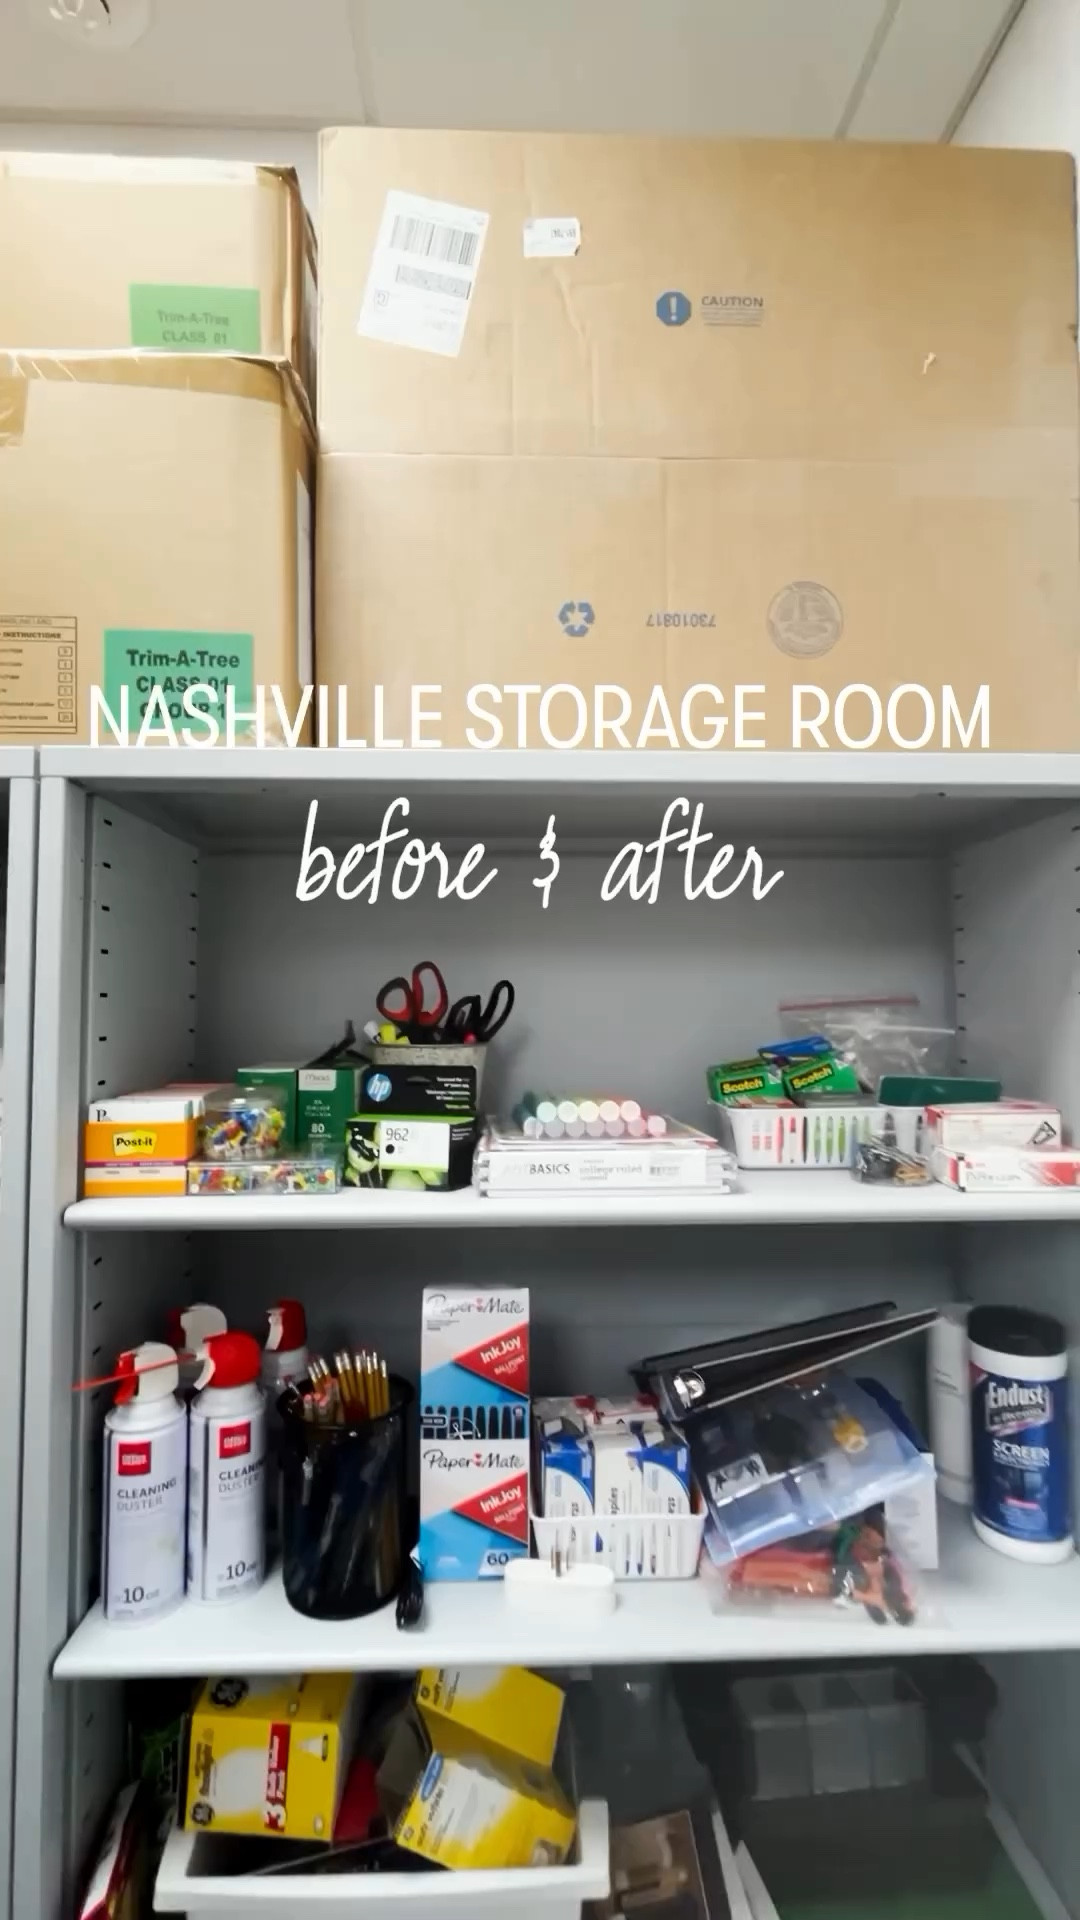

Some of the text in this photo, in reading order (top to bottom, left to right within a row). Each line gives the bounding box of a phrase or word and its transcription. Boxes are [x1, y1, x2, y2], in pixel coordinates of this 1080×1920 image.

[701, 295, 764, 307] CAUTION
[161, 329, 207, 343] CLASS
[126, 649, 240, 669] Trim-A-Tree
[721, 1077, 764, 1095] Scotch
[792, 1064, 834, 1090] Scotch
[368, 1073, 392, 1103] hp
[115, 1137, 154, 1147] Post-it
[385, 1127, 410, 1142] 962
[480, 1336, 521, 1365] InkJoy
[987, 1382, 1045, 1409] Endust
[423, 1448, 525, 1472] Paper Mate
[116, 1476, 177, 1500] CLEANING
[480, 1485, 522, 1514] InkJoy
[486, 1553, 509, 1566] 60
[226, 1560, 246, 1581] 10
[123, 1586, 145, 1604] 10
